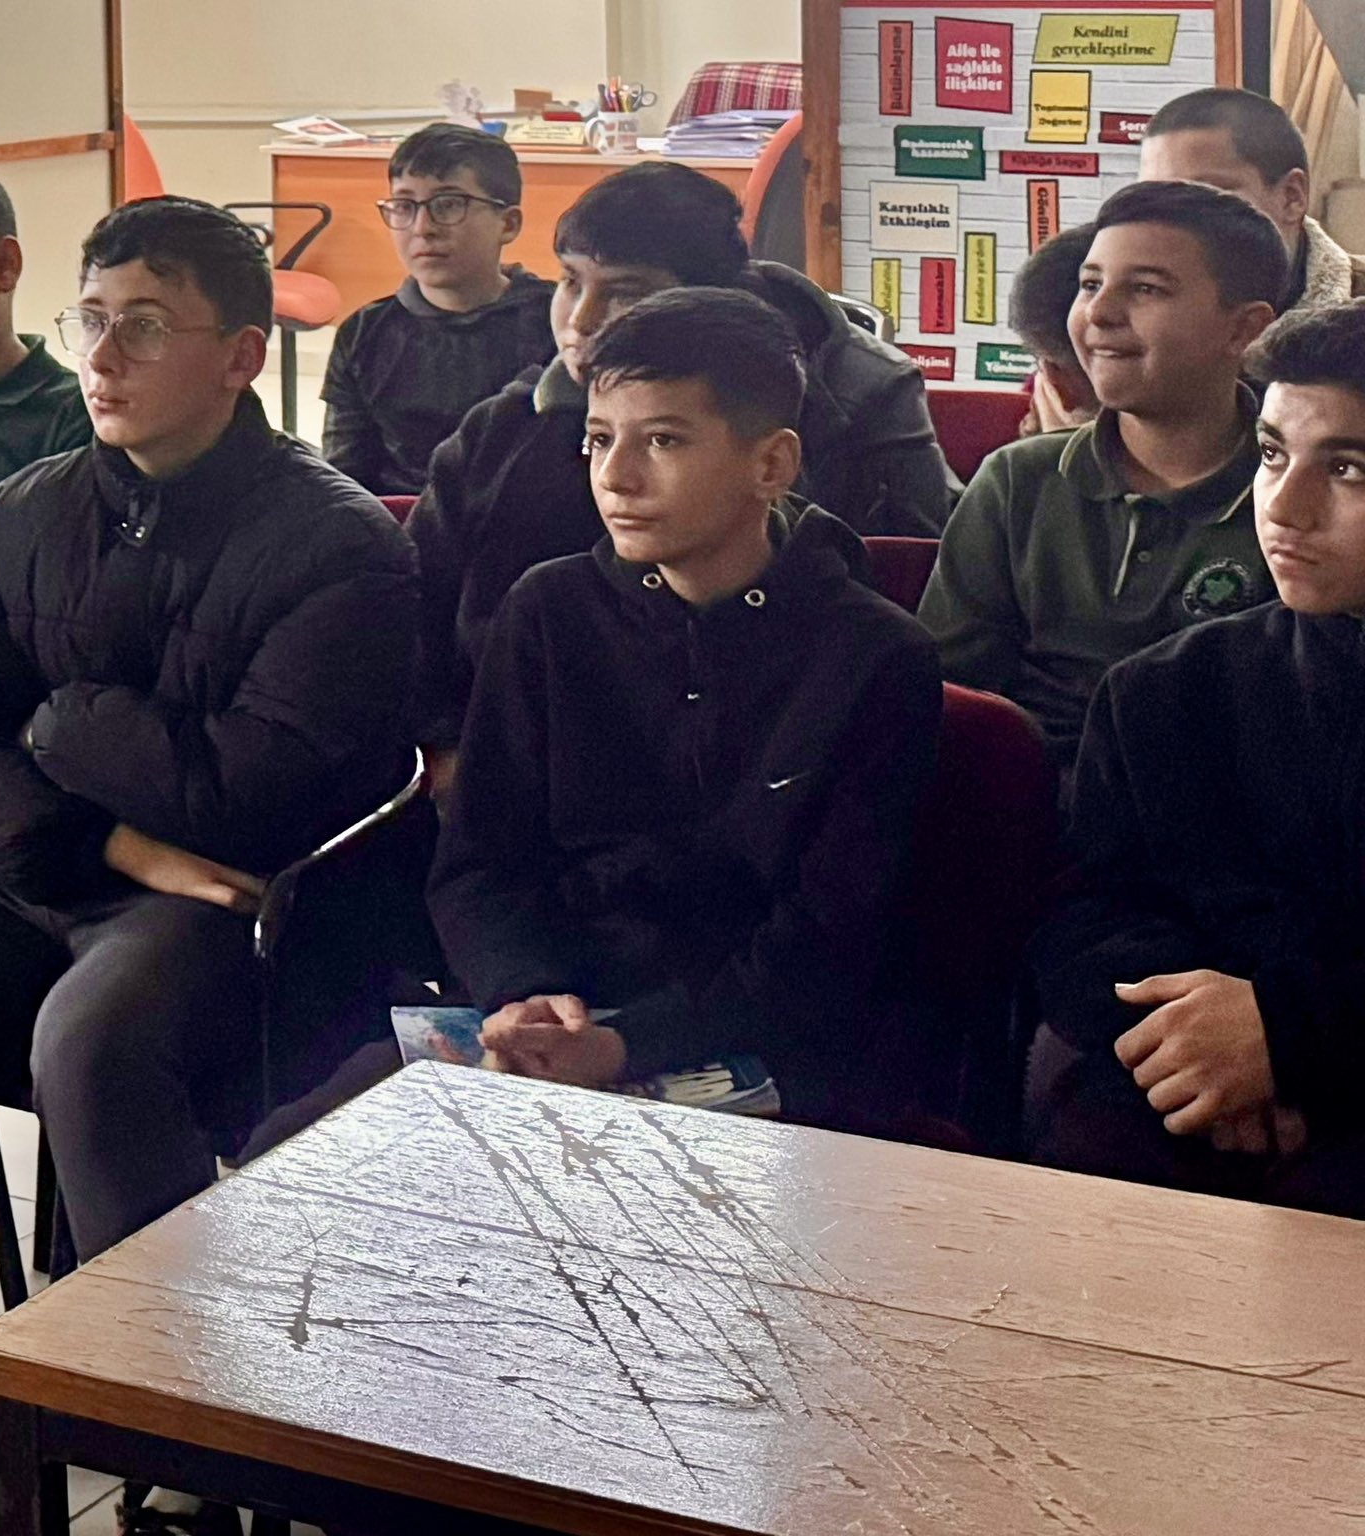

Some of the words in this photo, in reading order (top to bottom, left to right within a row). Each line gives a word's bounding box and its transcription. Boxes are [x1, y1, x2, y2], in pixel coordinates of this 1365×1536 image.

[1073, 25, 1129, 38] Kendini
[947, 42, 977, 57] Aile
[980, 43, 1001, 57] ile
[1051, 42, 1156, 58] gerçekleştirme
[945, 61, 1003, 77] sağlıklı
[945, 76, 1003, 93] ilişkiler
[879, 202, 950, 215] Karşılıklı
[910, 355, 950, 368] elişimi
